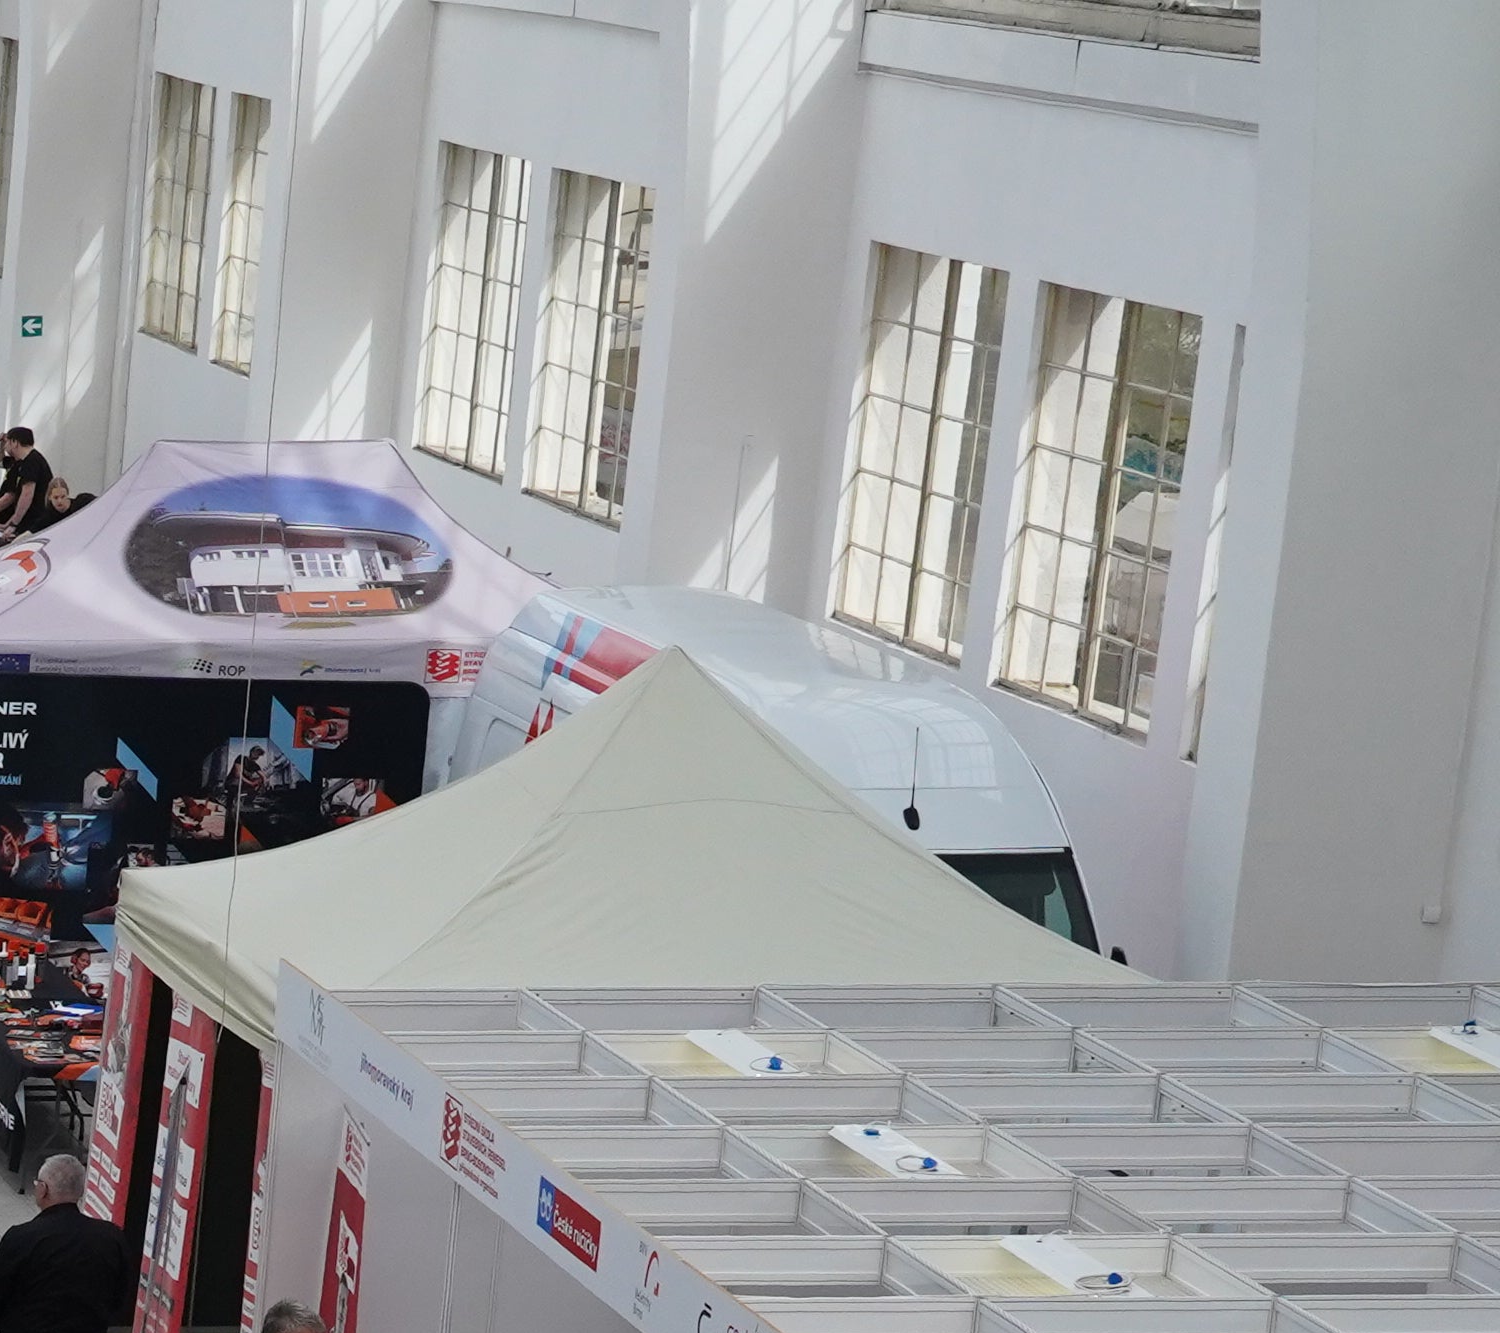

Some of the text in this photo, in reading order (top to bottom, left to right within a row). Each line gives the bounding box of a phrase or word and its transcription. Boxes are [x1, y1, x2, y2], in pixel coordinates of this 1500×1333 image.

[218, 664, 246, 677] ROP
[552, 1203, 598, 1263] České ručičky
